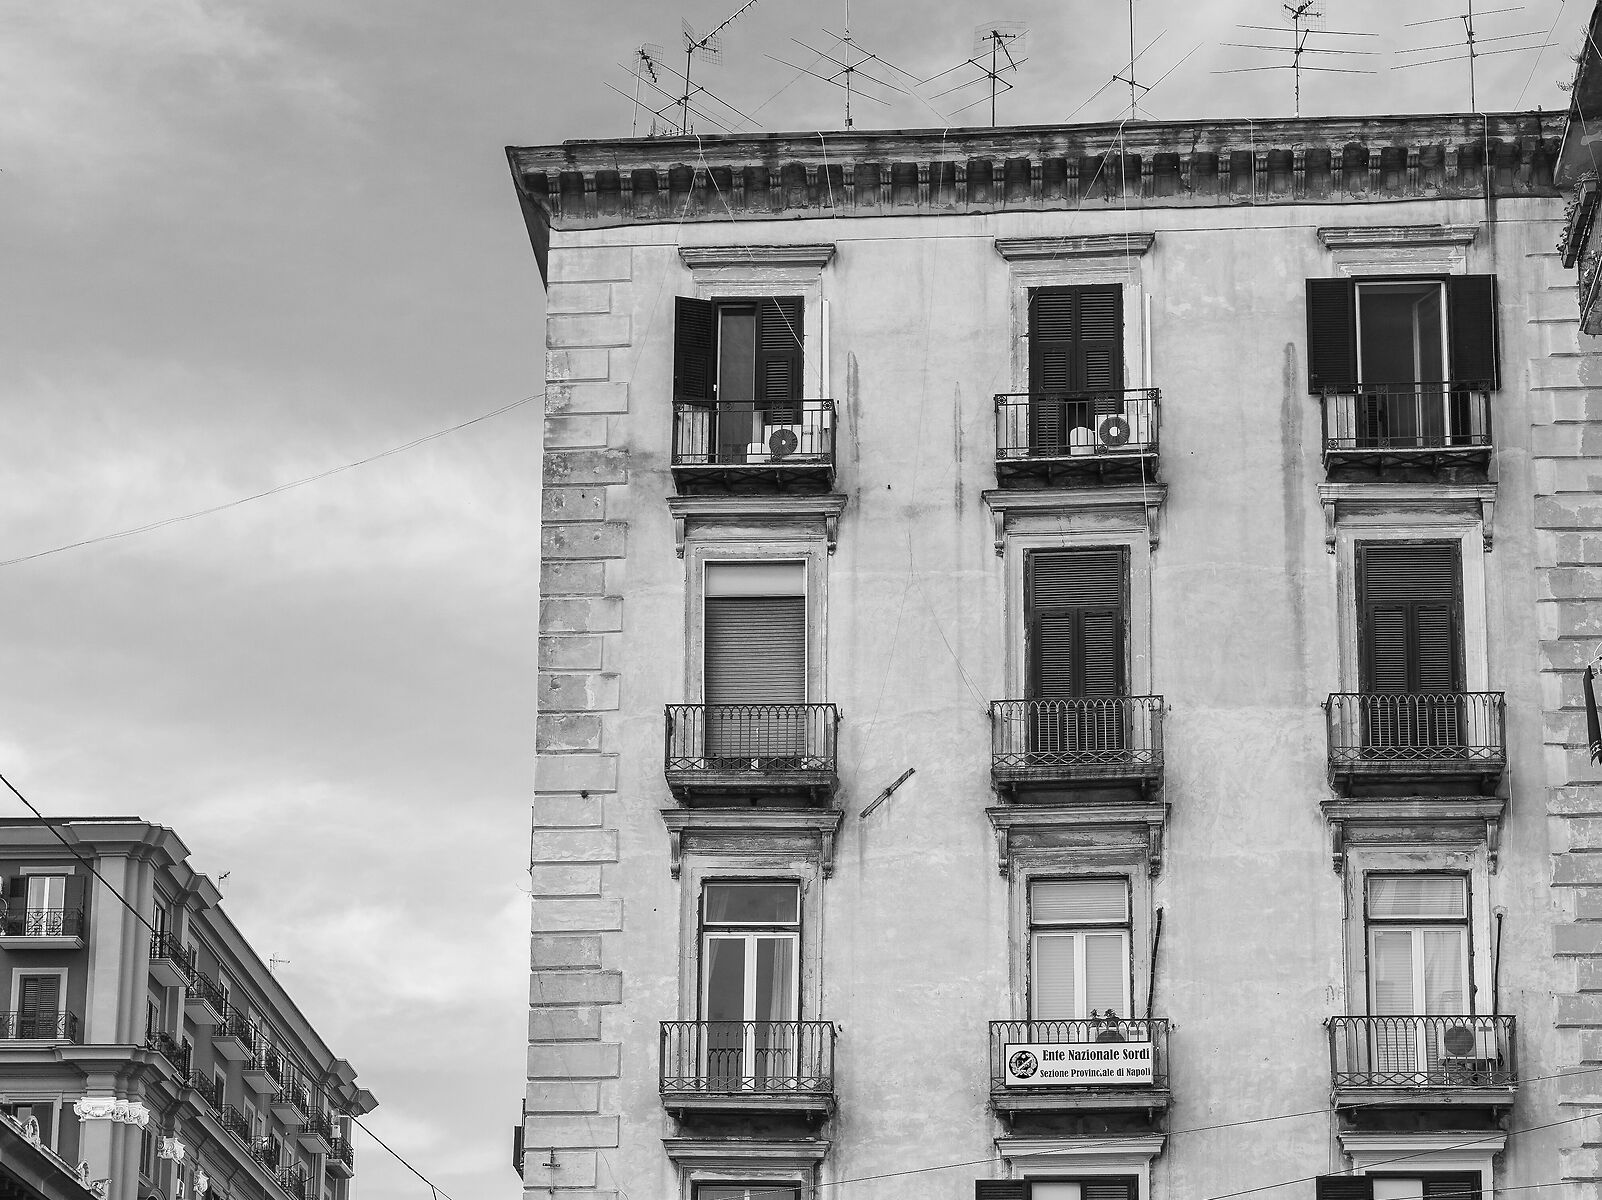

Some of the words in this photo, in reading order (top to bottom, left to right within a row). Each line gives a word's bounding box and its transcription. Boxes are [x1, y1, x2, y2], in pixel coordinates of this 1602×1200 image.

[1042, 1049, 1066, 1061] Ente
[1068, 1049, 1119, 1061] Nazionale
[1122, 1048, 1150, 1060] Sordi
[1040, 1069, 1069, 1078] Sezione
[1117, 1068, 1124, 1077] di
[1126, 1067, 1150, 1078] Napoli
